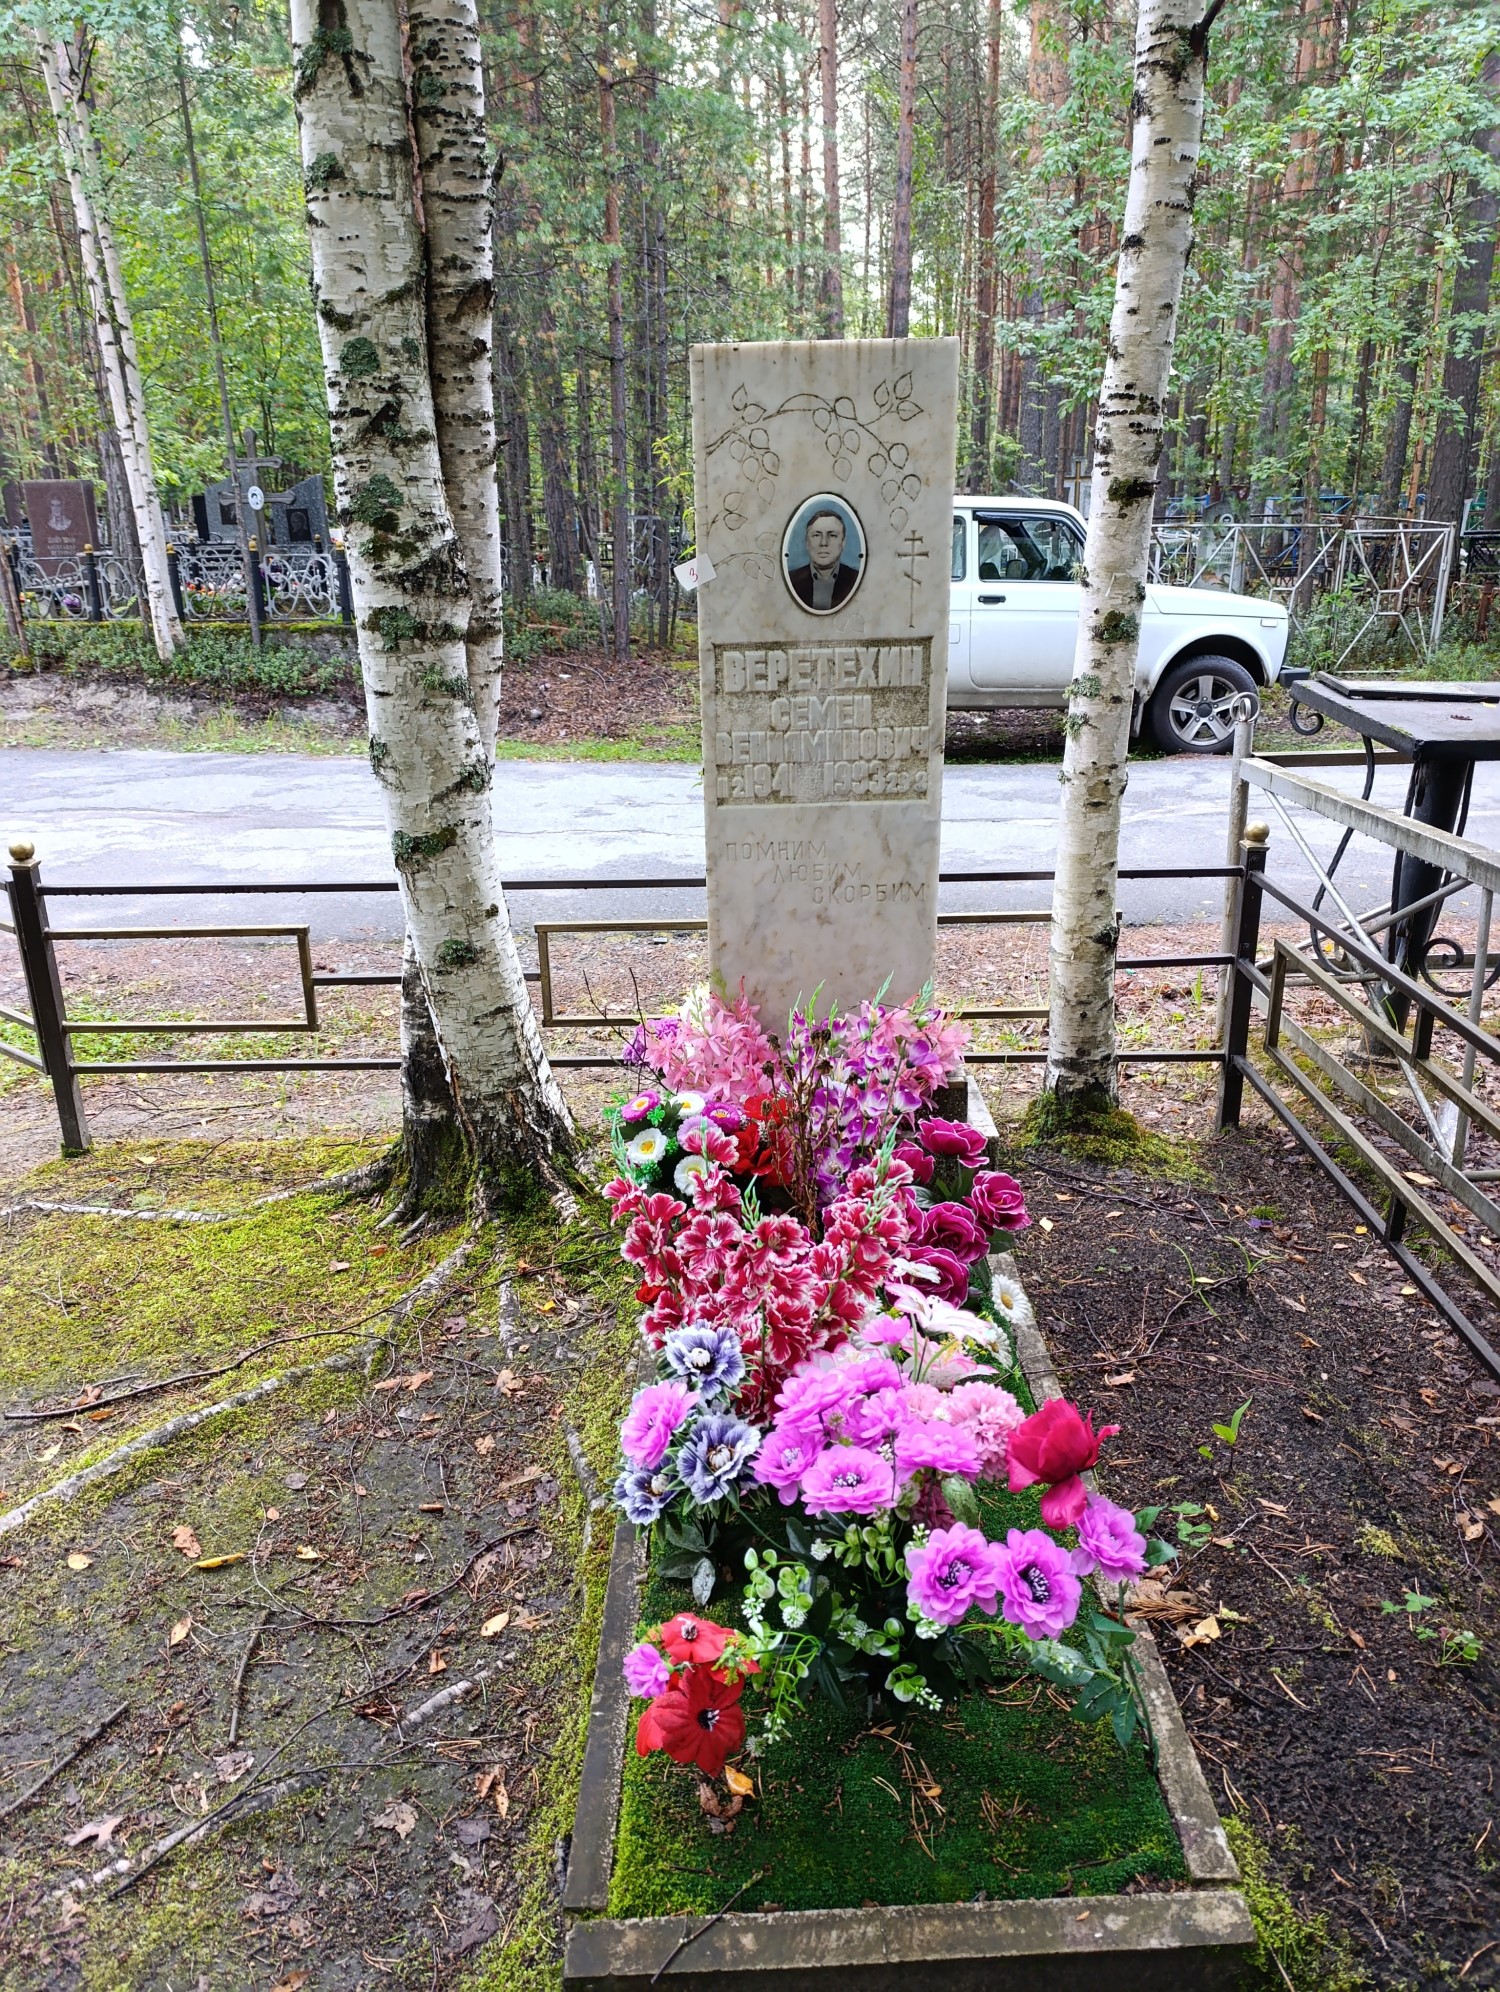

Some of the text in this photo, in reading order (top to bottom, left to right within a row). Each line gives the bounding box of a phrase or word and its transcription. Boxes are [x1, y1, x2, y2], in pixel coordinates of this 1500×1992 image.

[723, 646, 924, 692] ВЕРЕТЕХИН
[771, 695, 872, 730] СЕМЕН
[716, 726, 930, 764] ВЕНИАМИНОВИЧ
[744, 763, 798, 798] 1941
[823, 761, 887, 796] 1993
[725, 840, 828, 861] ПОМНИМ
[773, 862, 862, 883] ЛЮБИМ
[812, 883, 926, 904] СКОРБИМ
